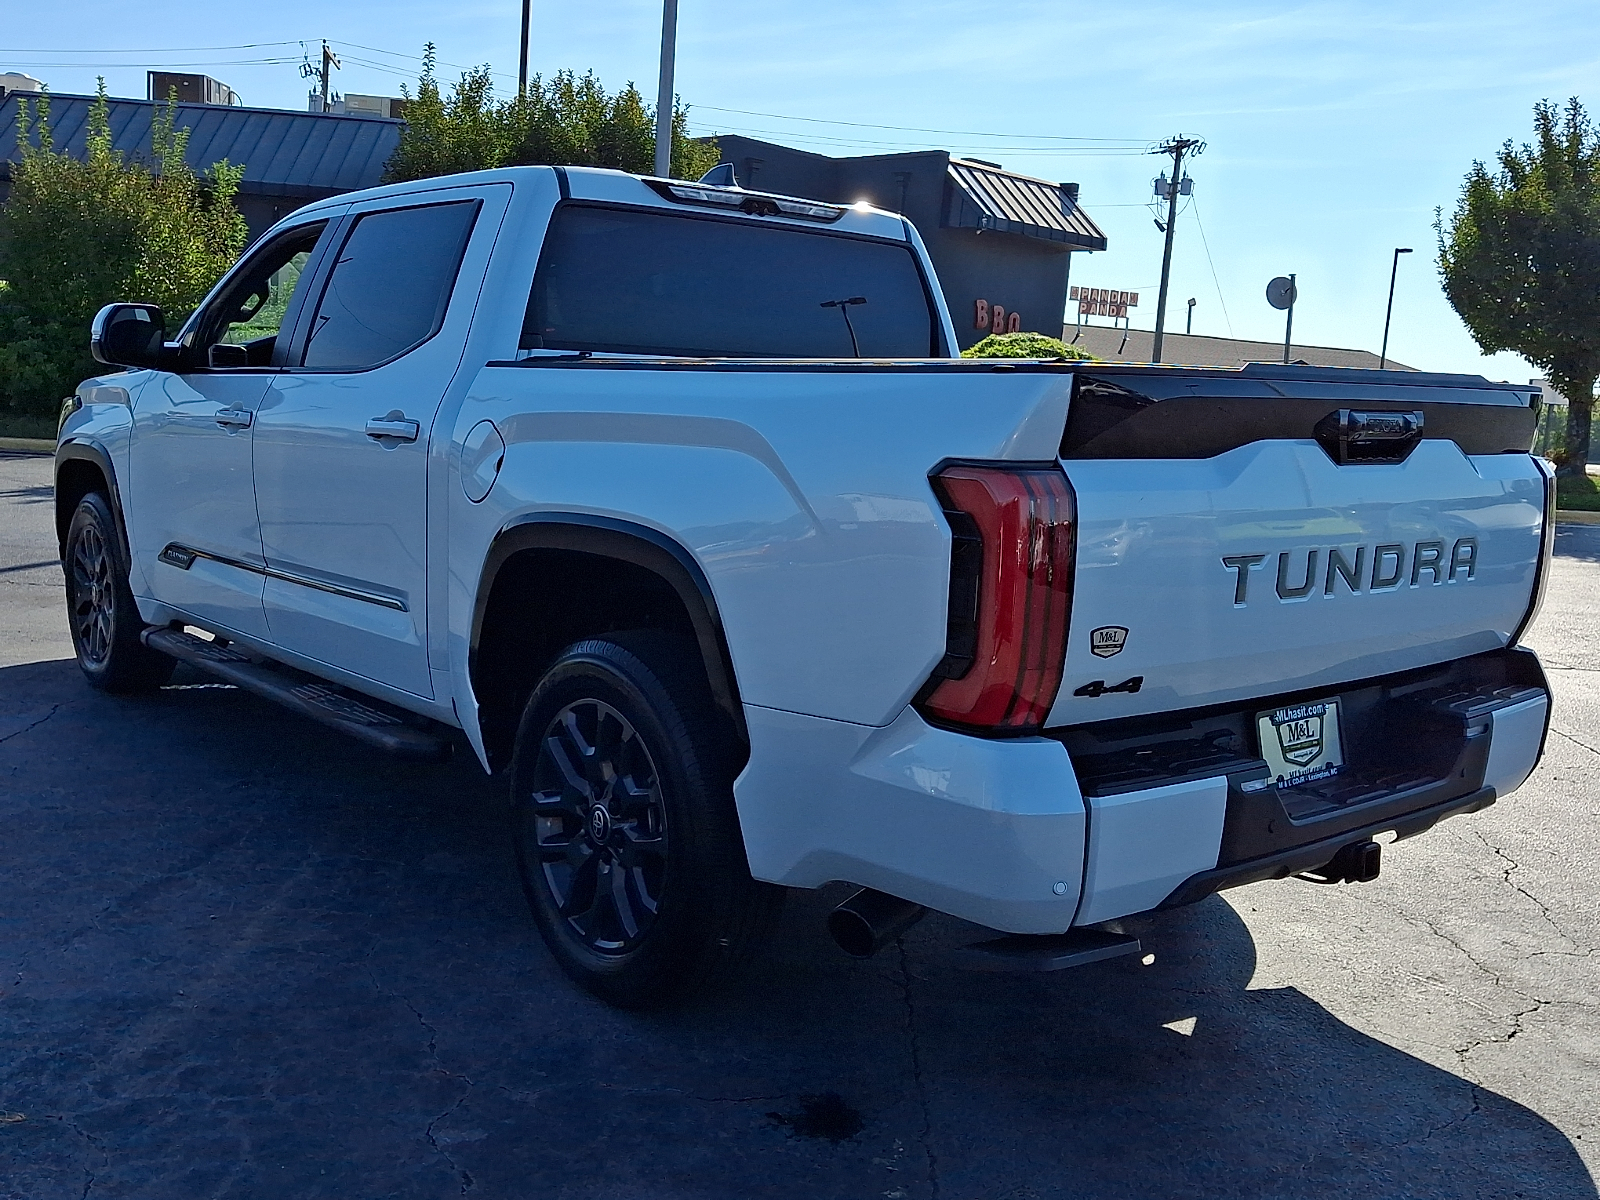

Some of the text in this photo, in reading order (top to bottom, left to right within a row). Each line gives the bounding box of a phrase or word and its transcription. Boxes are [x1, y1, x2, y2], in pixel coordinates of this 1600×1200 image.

[1081, 287, 1129, 304] PANDA
[1080, 302, 1127, 317] PANDA
[1220, 536, 1479, 608] TUNDRA
[1098, 630, 1120, 644] M&L
[1286, 719, 1315, 743] M&L
